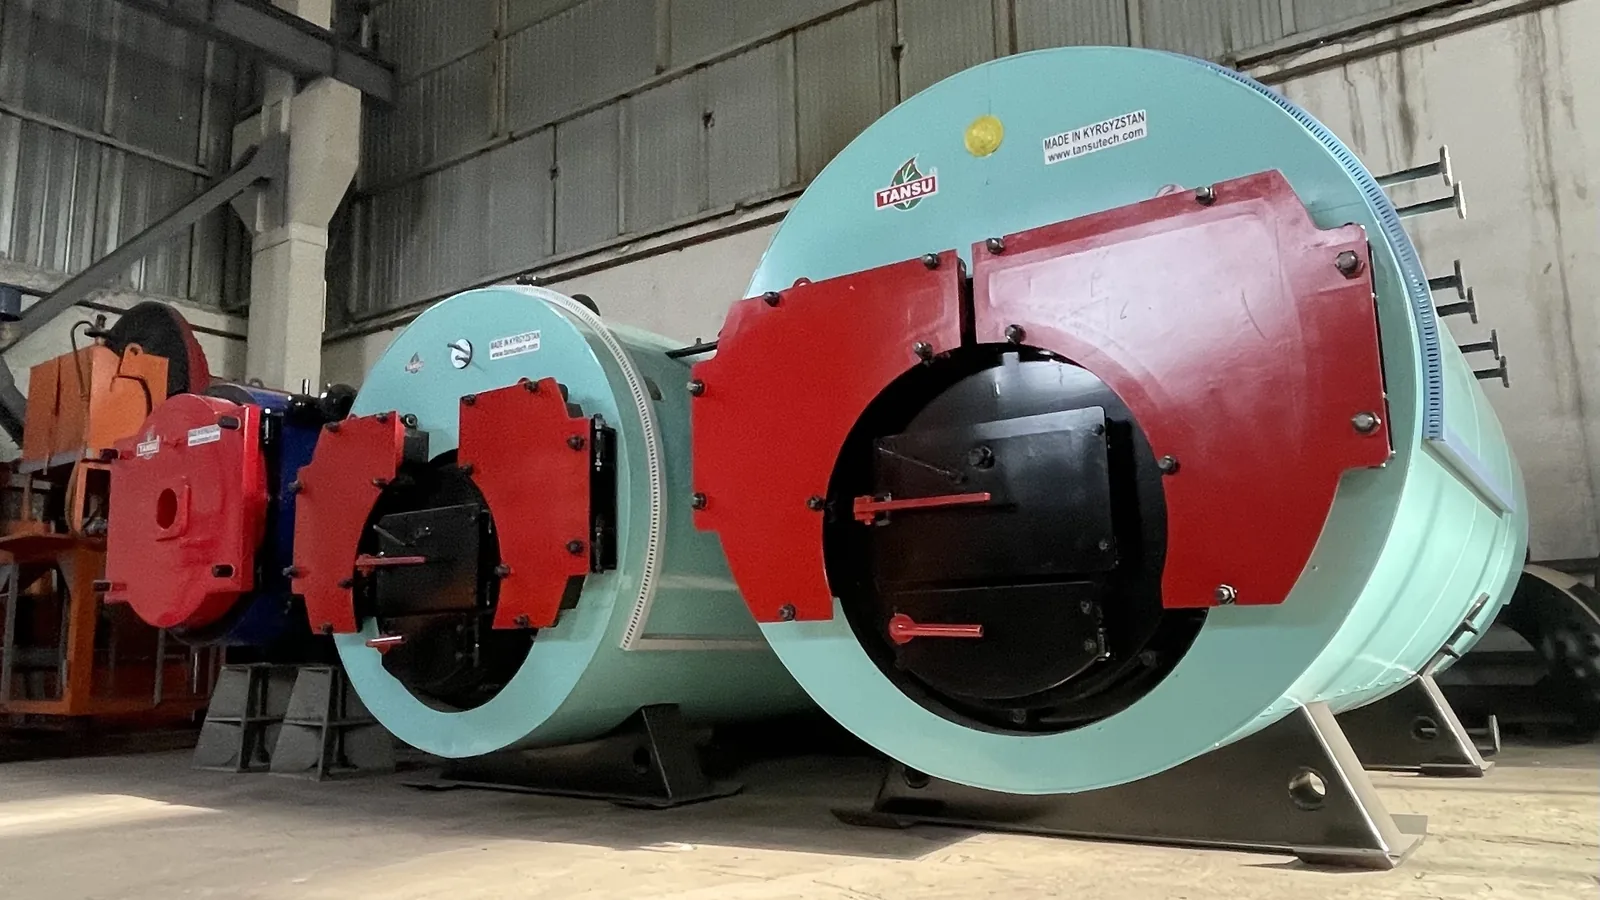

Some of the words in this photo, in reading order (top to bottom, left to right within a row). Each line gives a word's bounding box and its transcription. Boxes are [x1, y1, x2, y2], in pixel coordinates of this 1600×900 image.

[1044, 134, 1069, 150] MADE
[1072, 131, 1081, 142] IN
[1083, 111, 1145, 139] KYRGYZSTAN
[1047, 127, 1144, 162] www.tansutech.com
[879, 178, 934, 203] TANSU
